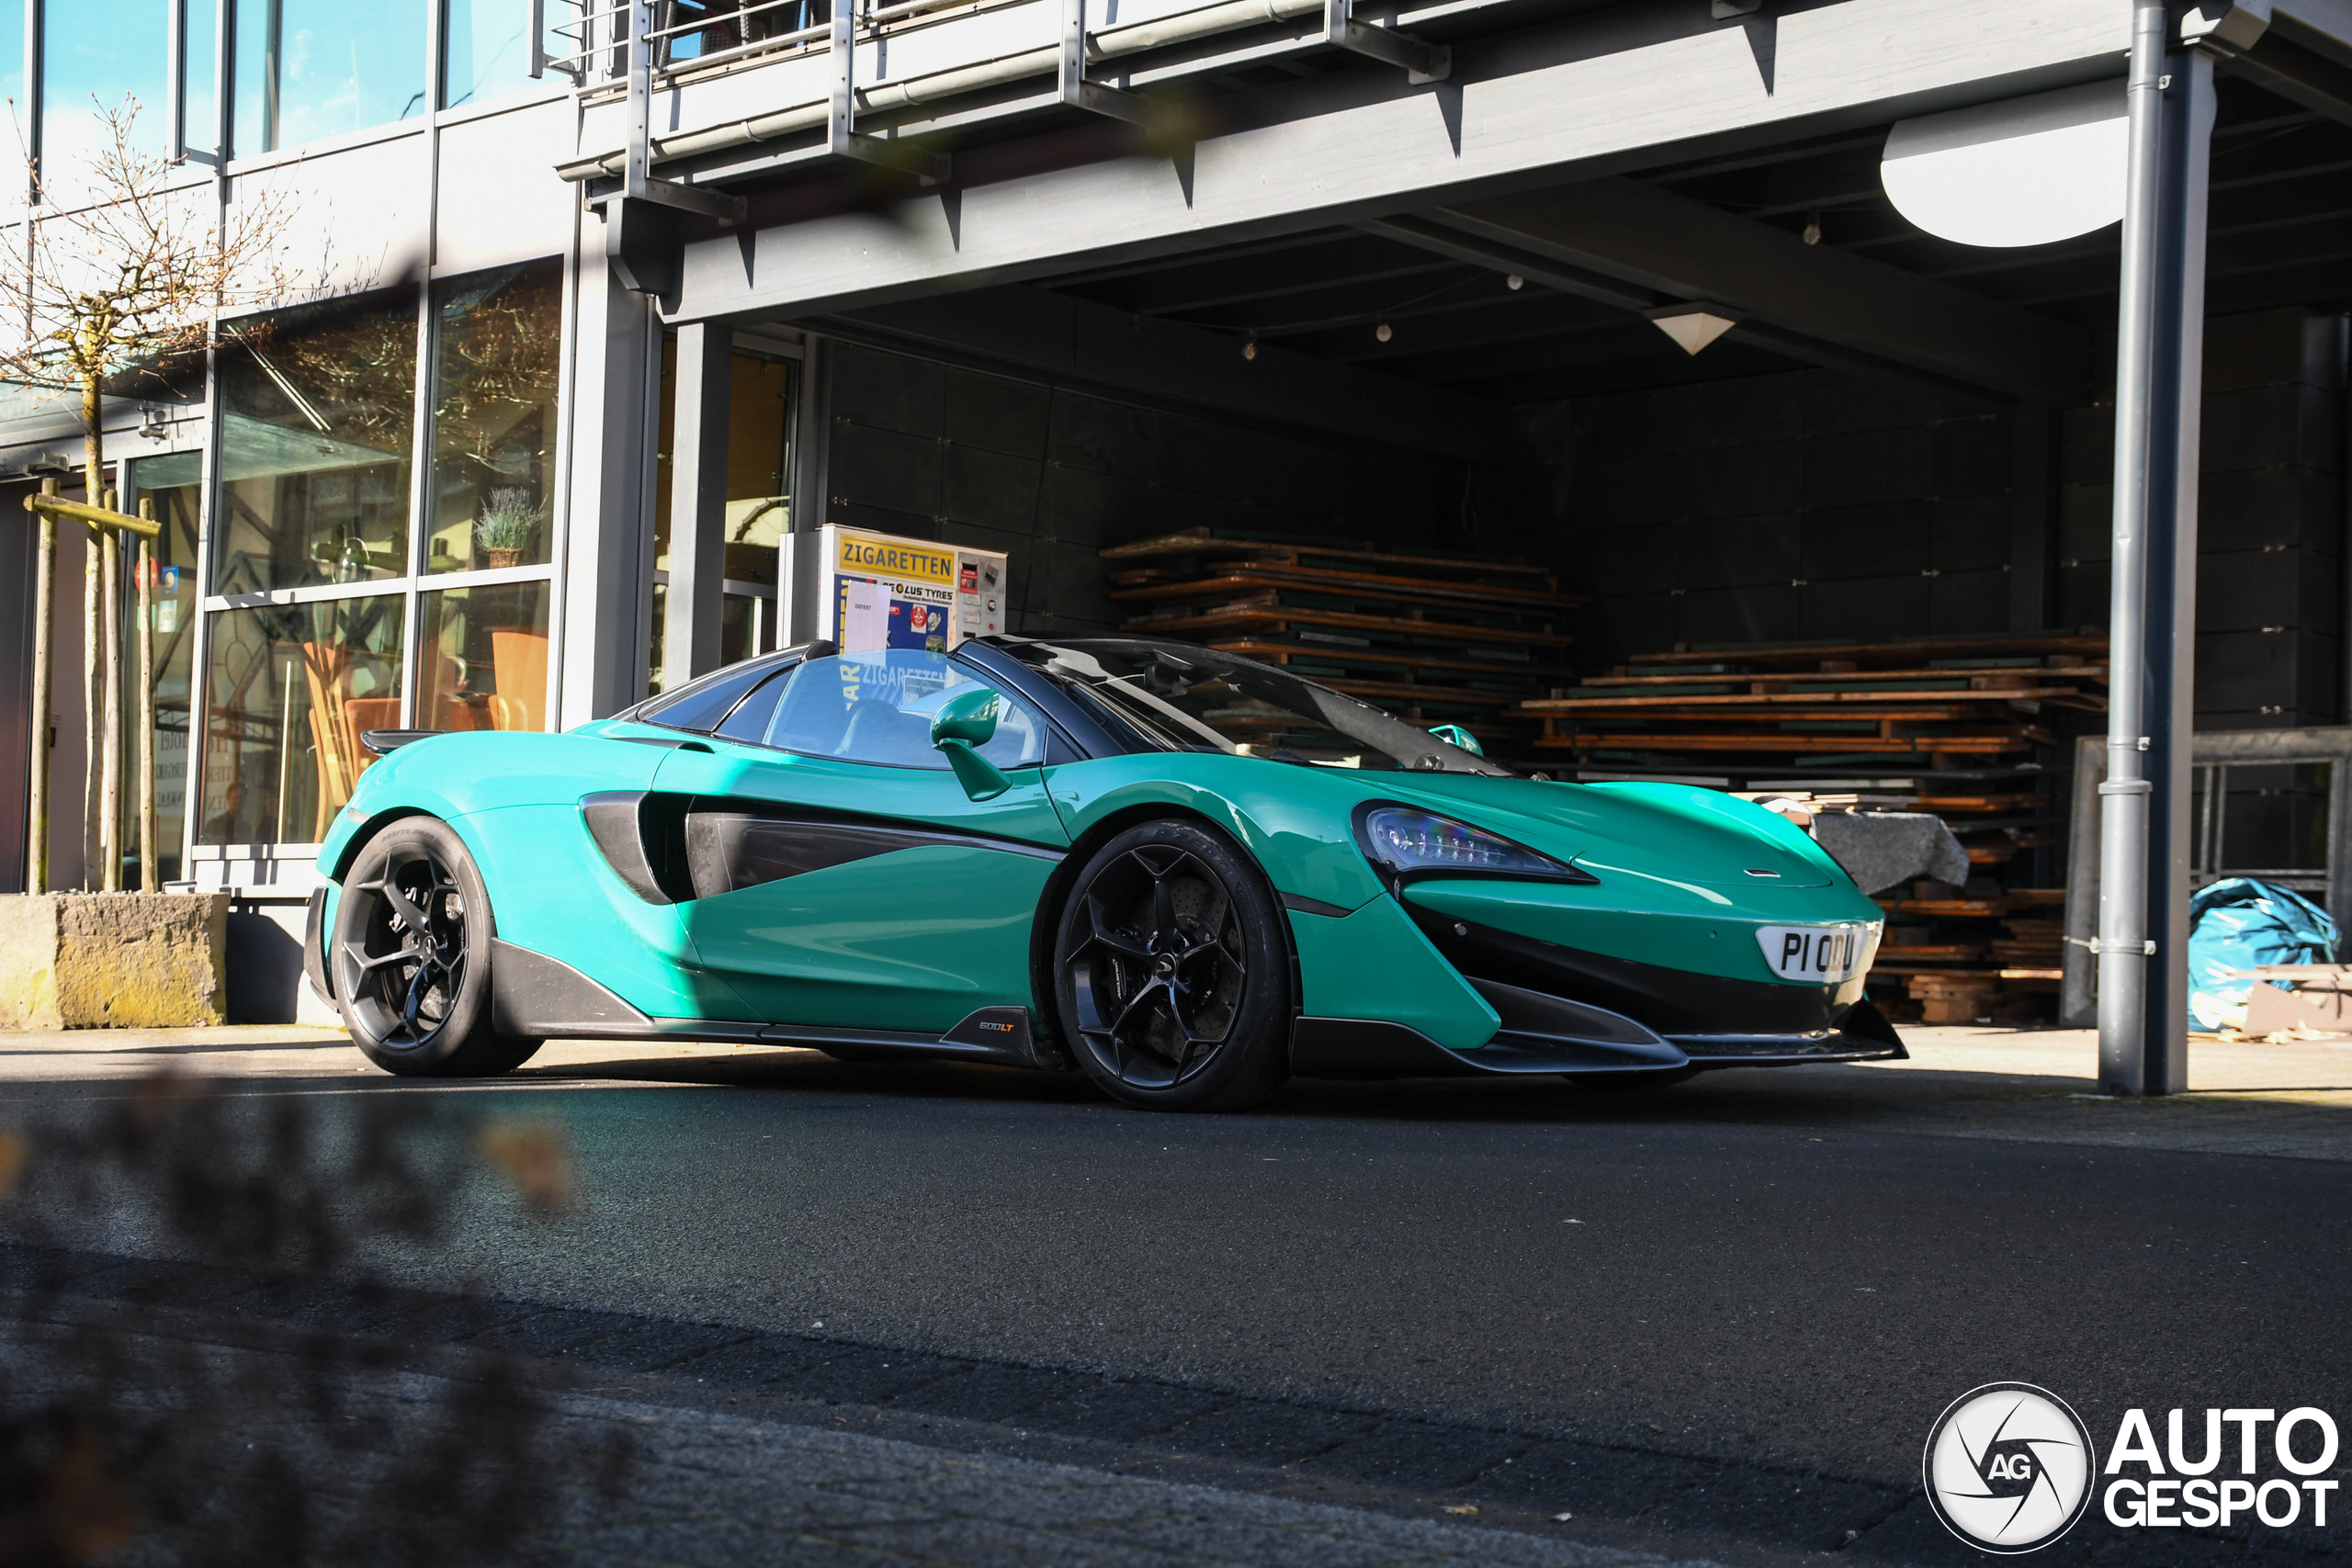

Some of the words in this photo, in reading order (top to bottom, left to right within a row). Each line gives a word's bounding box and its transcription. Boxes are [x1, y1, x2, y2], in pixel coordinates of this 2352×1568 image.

[843, 542, 951, 577] ZIGARETTEN
[925, 589, 953, 601] TYRES
[979, 1021, 1014, 1032] 600LT
